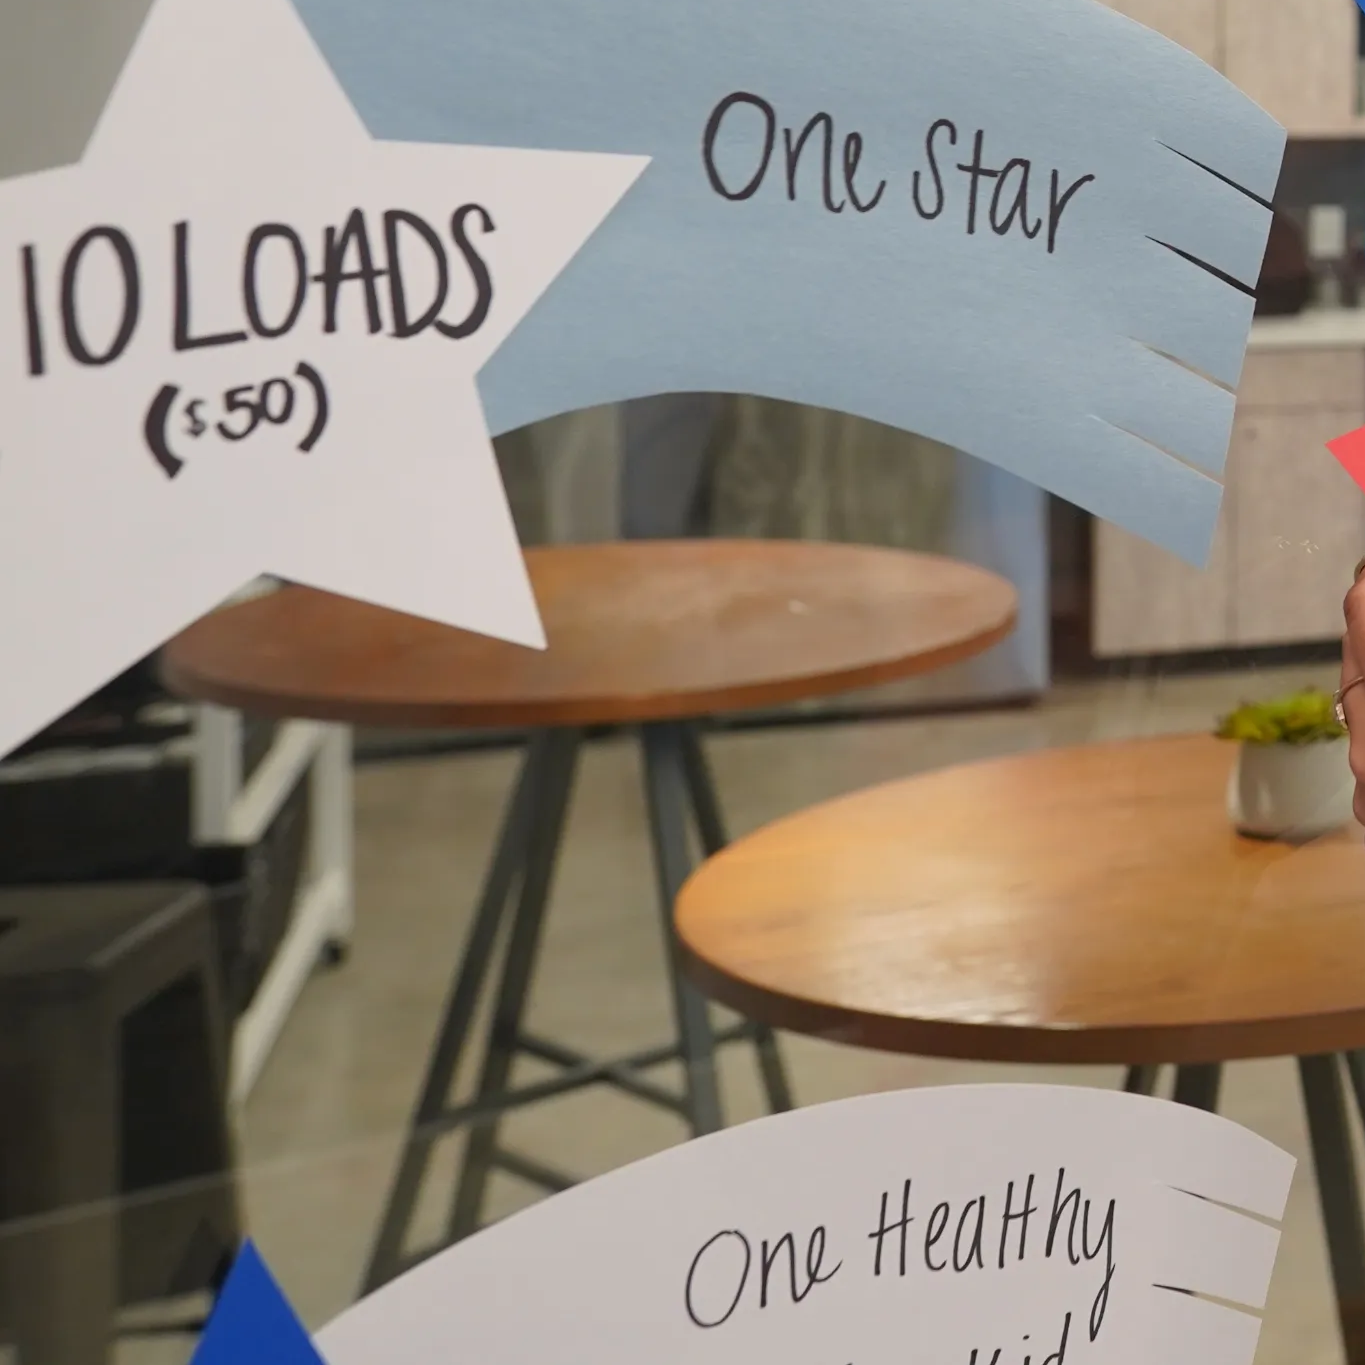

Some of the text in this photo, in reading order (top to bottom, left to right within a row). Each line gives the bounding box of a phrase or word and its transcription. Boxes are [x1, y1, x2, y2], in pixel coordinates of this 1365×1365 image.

[701, 90, 1097, 255] One Star
[20, 202, 497, 378] 10 LOADS
[142, 360, 330, 481] ($50)
[684, 1224, 843, 1329] One
